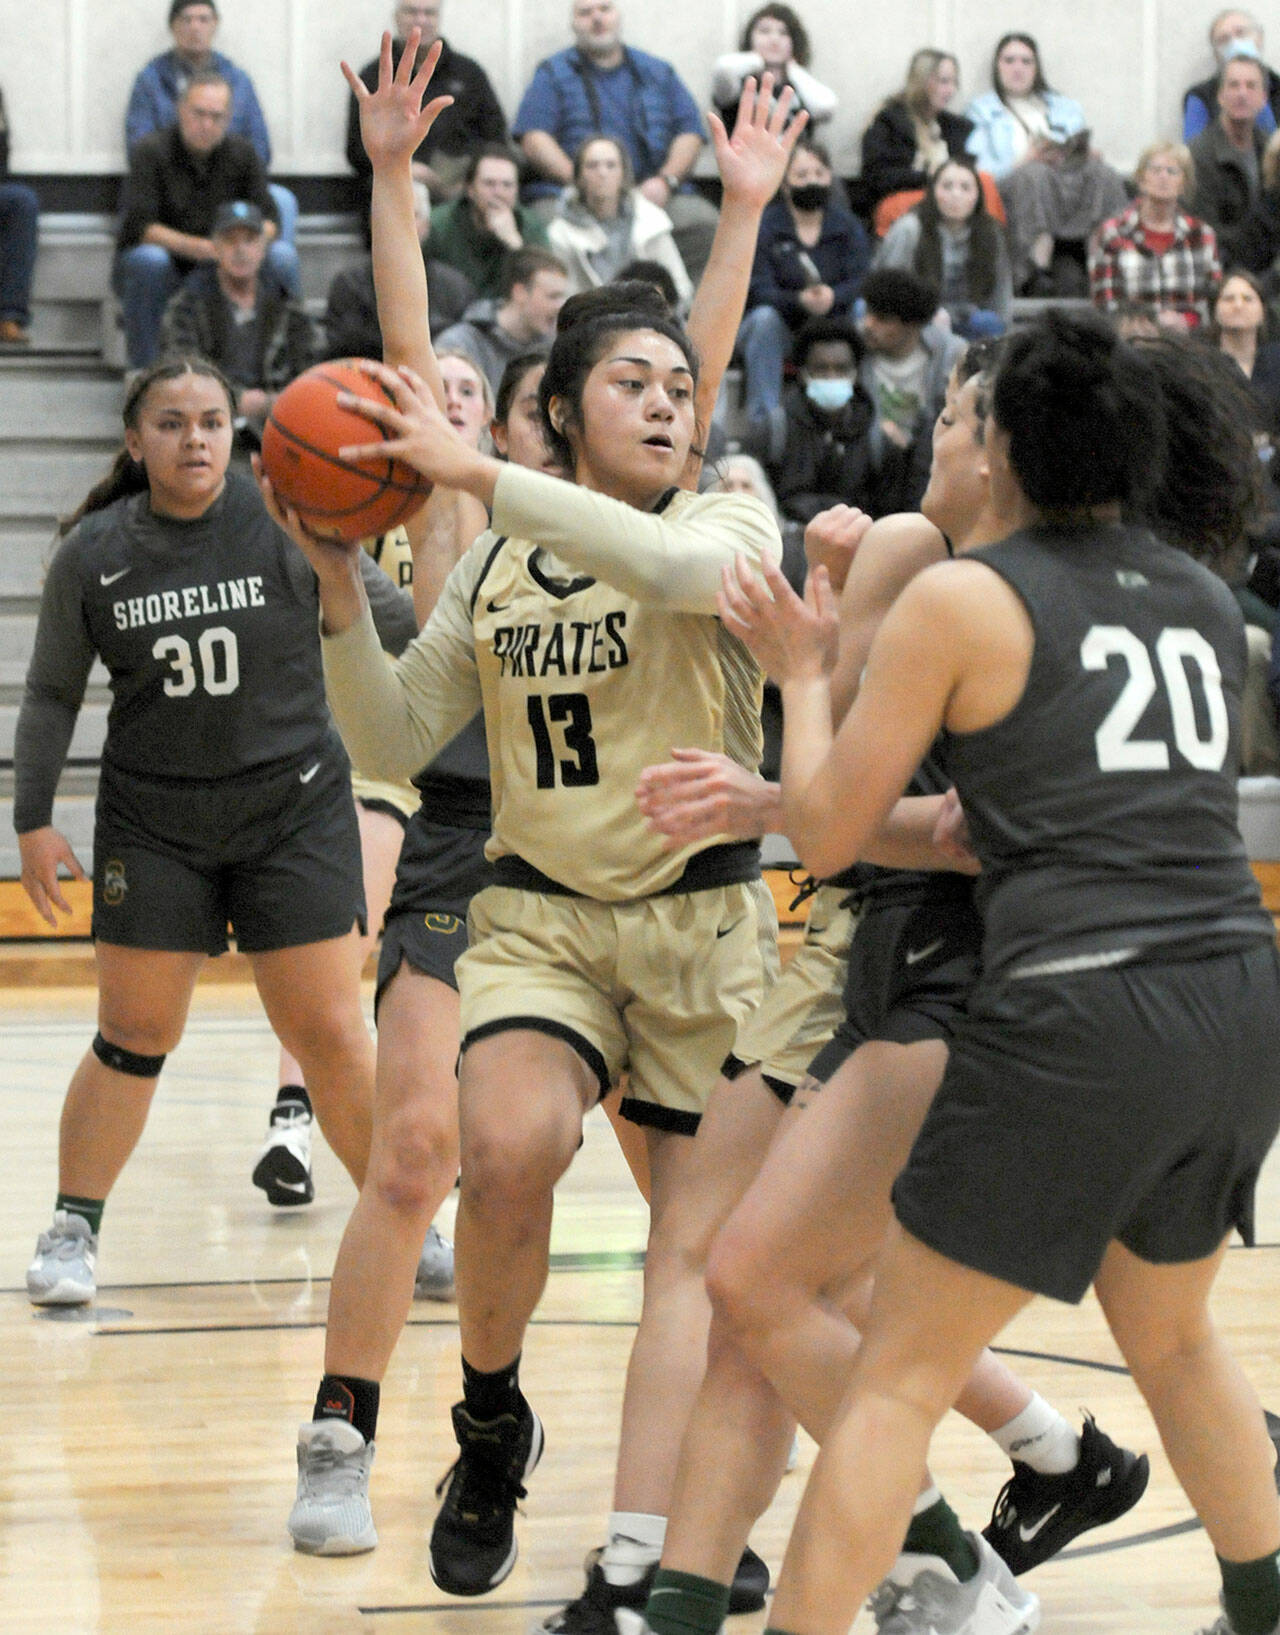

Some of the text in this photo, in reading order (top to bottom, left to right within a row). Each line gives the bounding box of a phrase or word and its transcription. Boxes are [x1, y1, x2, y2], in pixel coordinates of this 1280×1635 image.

[113, 576, 265, 631] SHORELINE
[152, 626, 239, 697] 30
[493, 610, 629, 677] PIRATES
[1080, 625, 1229, 772] 20
[527, 693, 599, 789] 13
